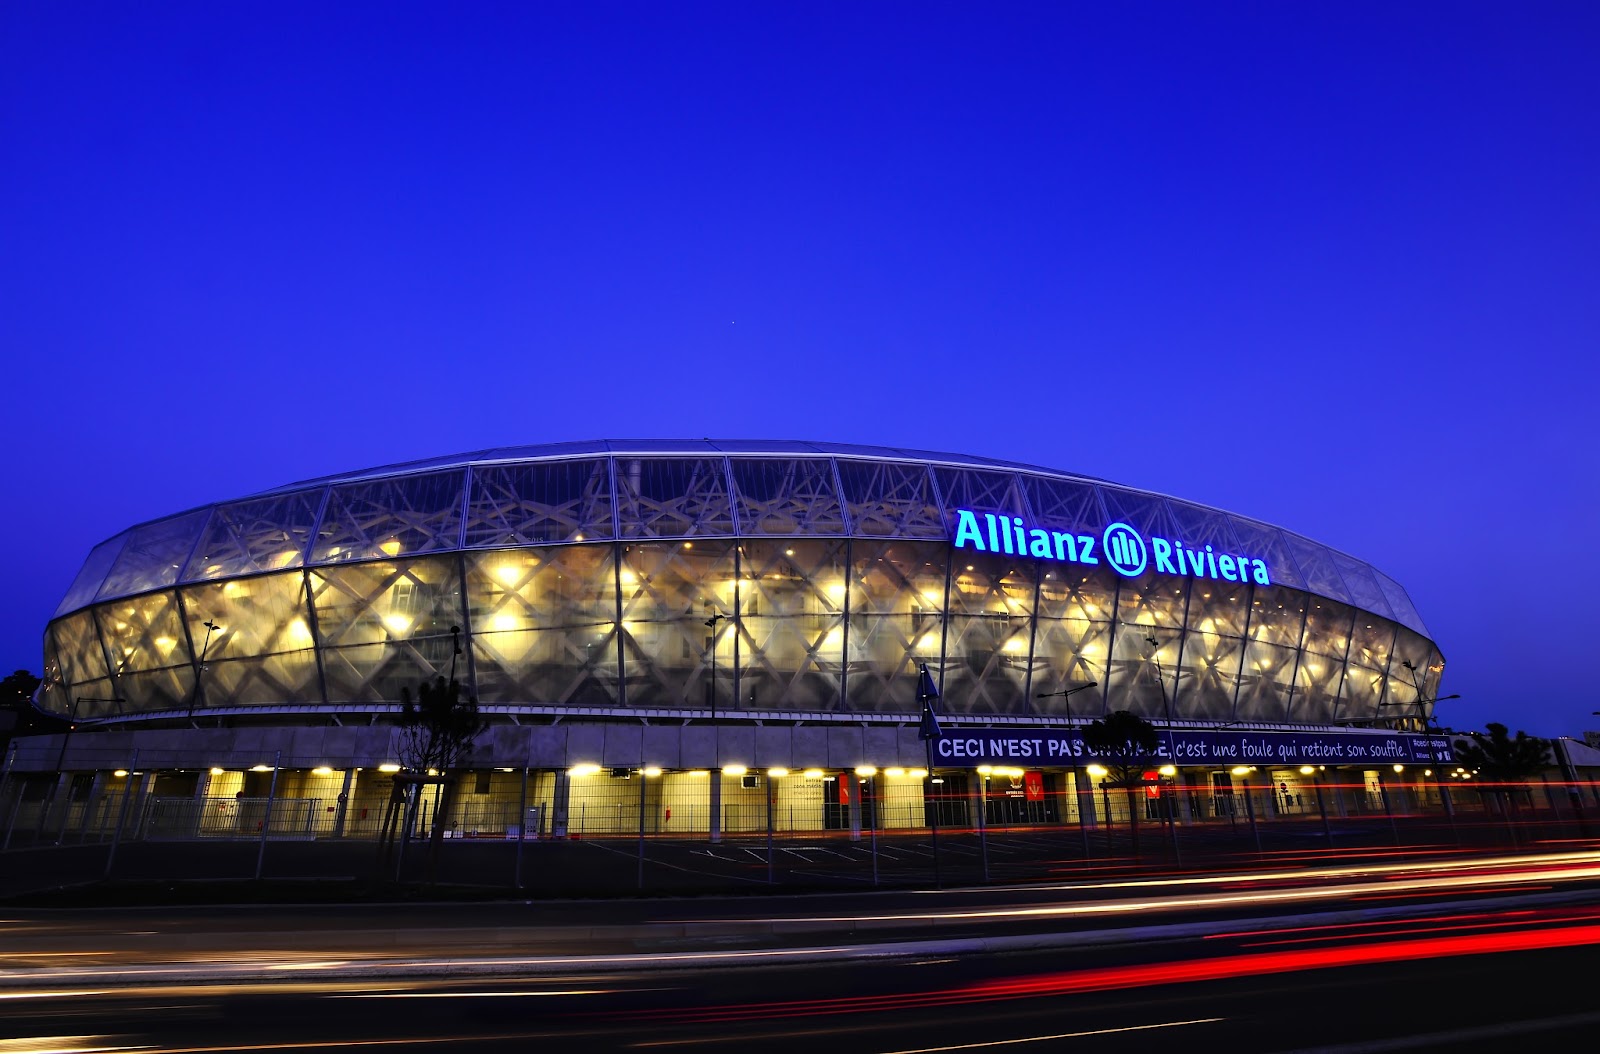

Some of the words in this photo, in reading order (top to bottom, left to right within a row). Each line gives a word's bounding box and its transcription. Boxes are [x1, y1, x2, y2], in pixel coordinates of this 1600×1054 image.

[954, 509, 1099, 565] Allianz
[1152, 537, 1270, 585] Riviera
[938, 739, 984, 757] CECI
[989, 739, 1042, 757] N'EST
[1048, 739, 1083, 757] PAS
[1176, 740, 1207, 757] c'est
[1212, 744, 1238, 757] une
[1242, 739, 1272, 757] foule
[1278, 740, 1297, 762] qui
[1301, 742, 1343, 757] retient
[1347, 744, 1367, 757] son
[1370, 740, 1407, 758] souffle.
